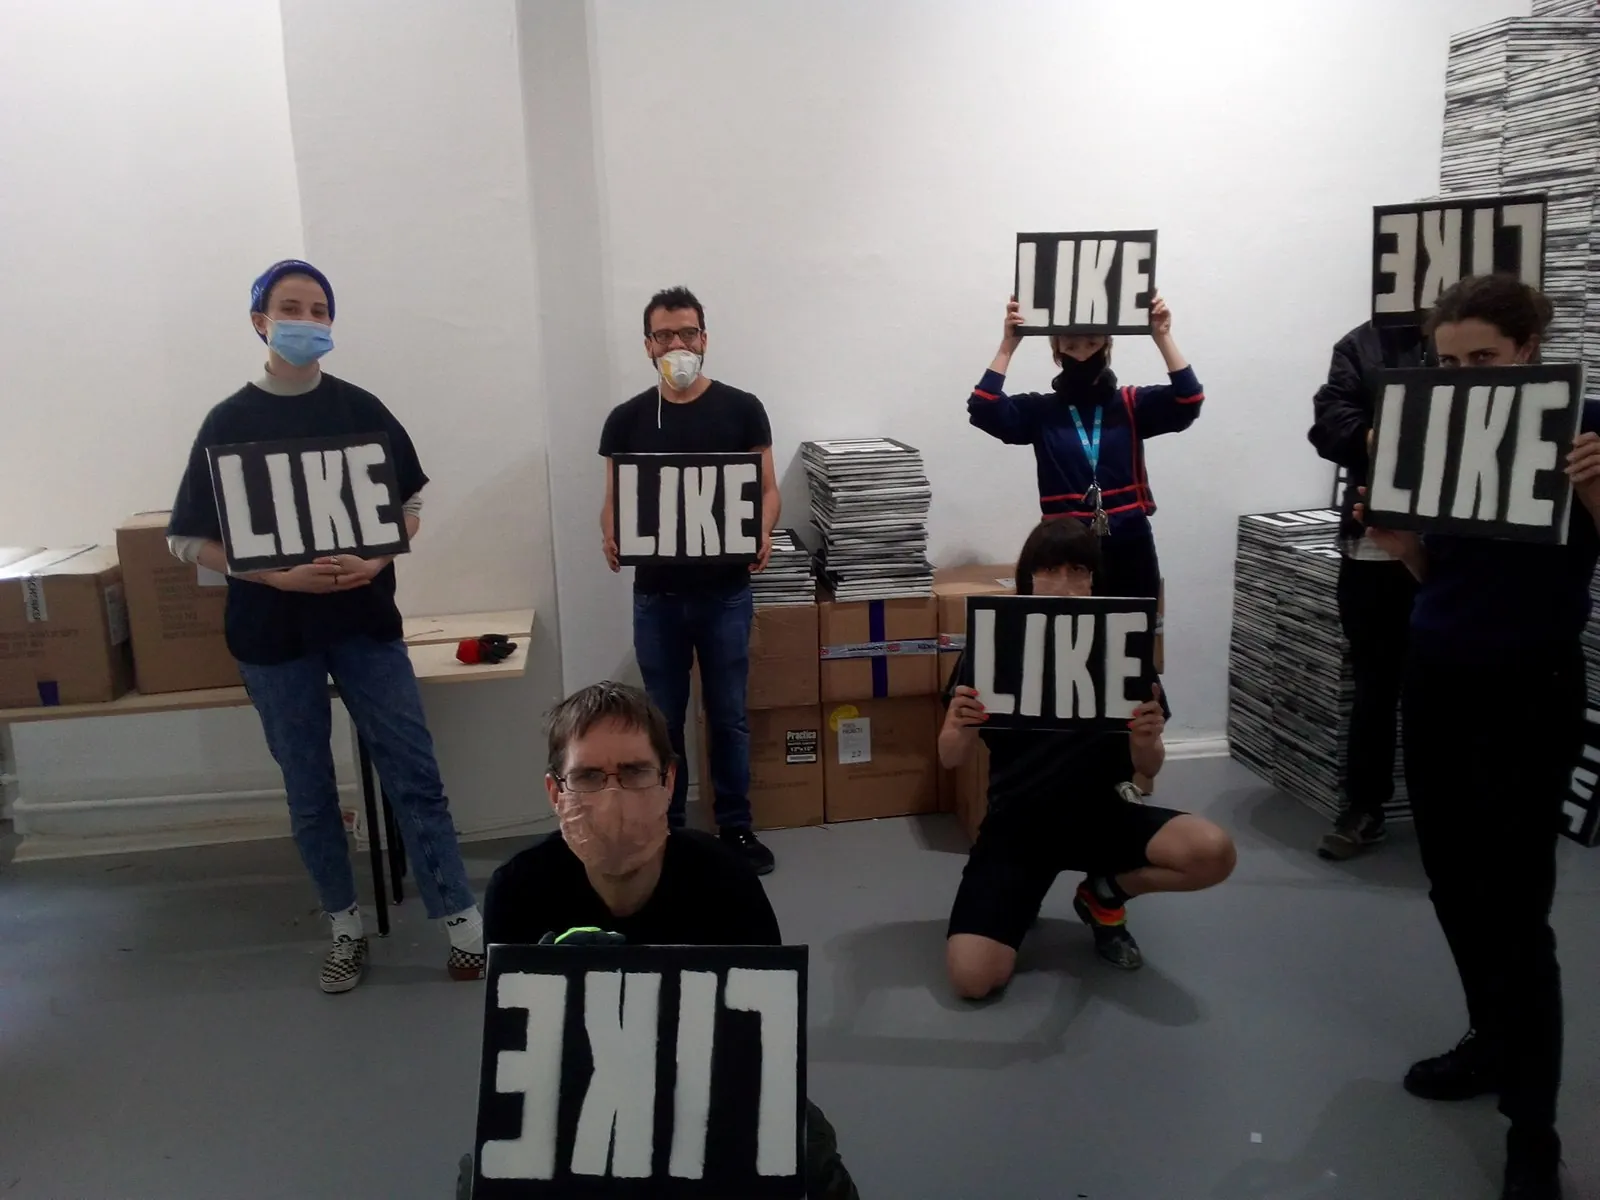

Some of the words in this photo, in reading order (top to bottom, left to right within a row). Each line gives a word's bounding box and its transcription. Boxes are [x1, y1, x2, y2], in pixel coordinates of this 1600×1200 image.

[1017, 239, 1151, 328] LIKE
[1375, 203, 1543, 313] LIKE
[217, 443, 401, 559] LIKE
[1370, 380, 1570, 527] LIKE
[618, 463, 758, 557] LIKE
[973, 609, 1148, 720] LIKE
[481, 967, 798, 1180] LIKE
